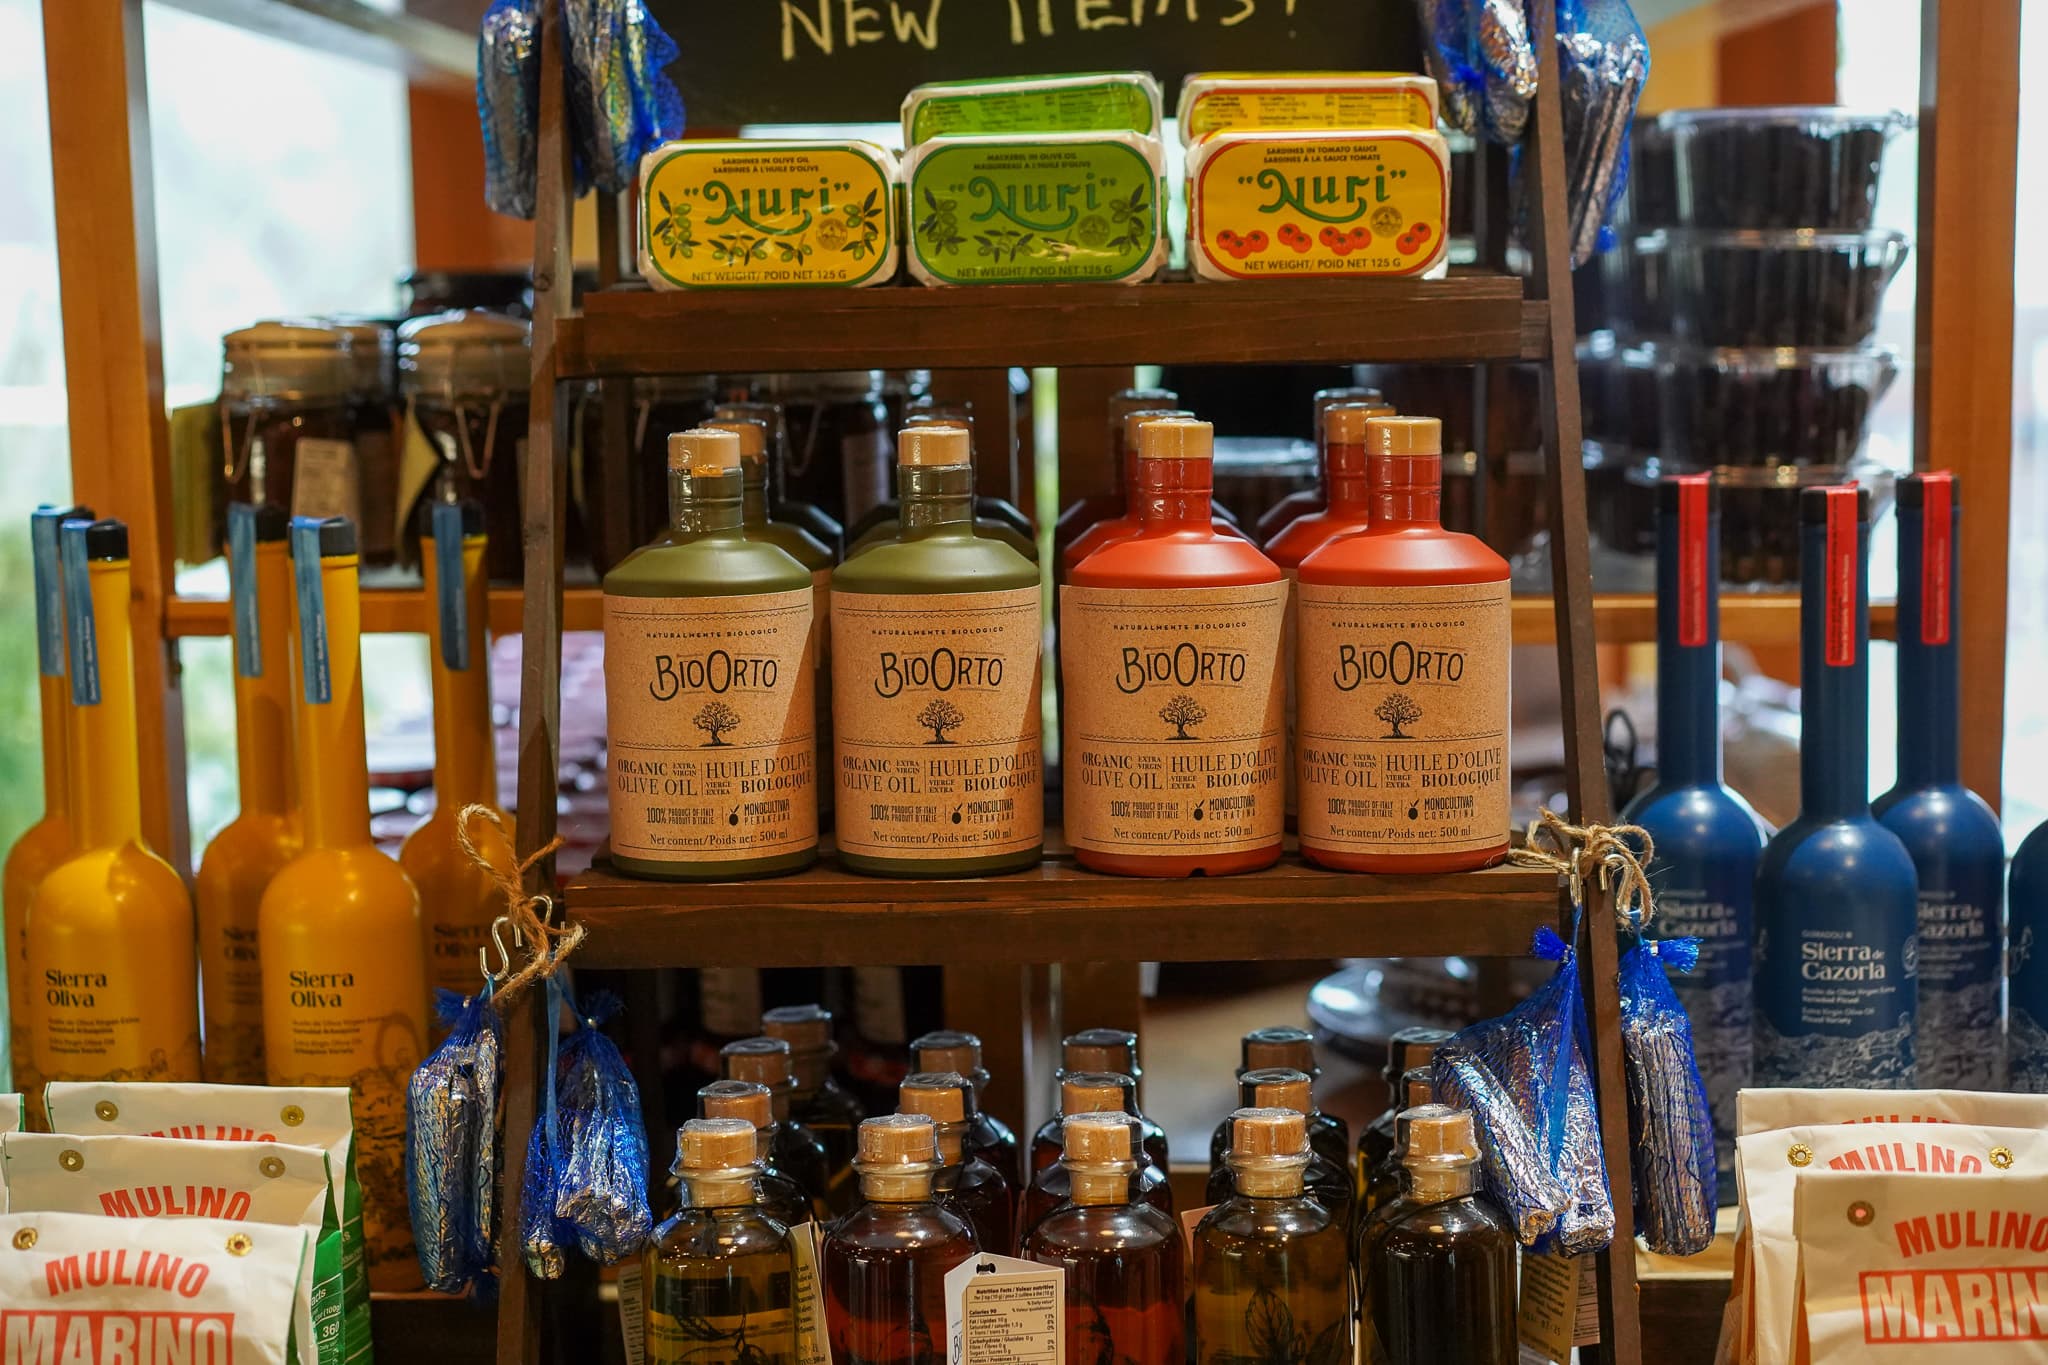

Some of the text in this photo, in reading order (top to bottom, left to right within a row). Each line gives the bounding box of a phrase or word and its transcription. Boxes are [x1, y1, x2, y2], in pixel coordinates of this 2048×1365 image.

[781, 0, 941, 61] NEW
[1318, 146, 1351, 154] TOMATO
[1353, 145, 1377, 153] SAUCE
[1264, 156, 1302, 164] SARDINES
[1312, 155, 1322, 163] LA
[1323, 154, 1348, 162] SAUCE
[958, 268, 977, 277] NET
[1030, 266, 1057, 276] POID
[1059, 266, 1079, 275] NET
[1083, 265, 1101, 275] 125
[1104, 265, 1112, 274] G
[1245, 260, 1264, 270] NET
[1318, 259, 1344, 269] POID
[1347, 259, 1367, 268] NET
[1370, 258, 1388, 268] 125
[1390, 258, 1401, 268] G
[692, 272, 711, 281] NET
[764, 271, 790, 280] POID
[794, 271, 813, 280] NET
[818, 271, 836, 279] 125
[838, 270, 847, 280] G
[727, 628, 778, 637] BIOLOGICO
[951, 626, 1003, 635] BIOLOGICO
[618, 759, 668, 776] ORGANIC
[706, 751, 811, 779] HUILE D'OLIVE
[843, 757, 891, 773] ORGANIC
[929, 751, 1037, 776] HUILE D'OLIVE
[1082, 752, 1133, 769] ORGANIC
[1171, 746, 1278, 773] HUILE D'OLIVE
[1303, 750, 1348, 767] ORGANIC
[1386, 747, 1501, 772] HUILE D'OLIVE
[741, 771, 811, 794] BIOLOGIQUE
[843, 774, 920, 794] OLIVE OIL
[964, 769, 1037, 792] BIOLOGIQUE
[1082, 769, 1162, 790] OLIVE OIL
[1207, 766, 1278, 788] BIOLOGIQUE
[1303, 768, 1376, 788] OLIVE OIL
[1422, 768, 1500, 790] BIOLOGIQUE
[618, 777, 698, 796] OLIVE OIL
[967, 799, 1013, 813] MONOCULTIVAR
[1111, 801, 1131, 817] 100%
[1327, 798, 1346, 815] 100%
[1424, 795, 1474, 810] MONOCULTIVAR
[647, 807, 667, 824] 100%
[871, 805, 890, 821] 100%
[650, 830, 788, 846] Net content/Poids net: 500 ml
[873, 829, 1012, 844] Net content/Poids net: 500 ml
[1113, 825, 1253, 840] Net content/Poids net: 500 ml
[1330, 825, 1471, 839] Net content/Poids net: 500 ml
[1802, 942, 1871, 961] Sierra
[45, 969, 108, 989] Sierra
[1802, 961, 1885, 980] Cazorla
[289, 971, 355, 989] Sierra
[47, 989, 96, 1008] Oliva
[290, 990, 342, 1009] Oliva
[99, 1186, 252, 1221] MULINO
[45, 1249, 210, 1299] MULINO
[4, 1313, 228, 1365] MARINO
